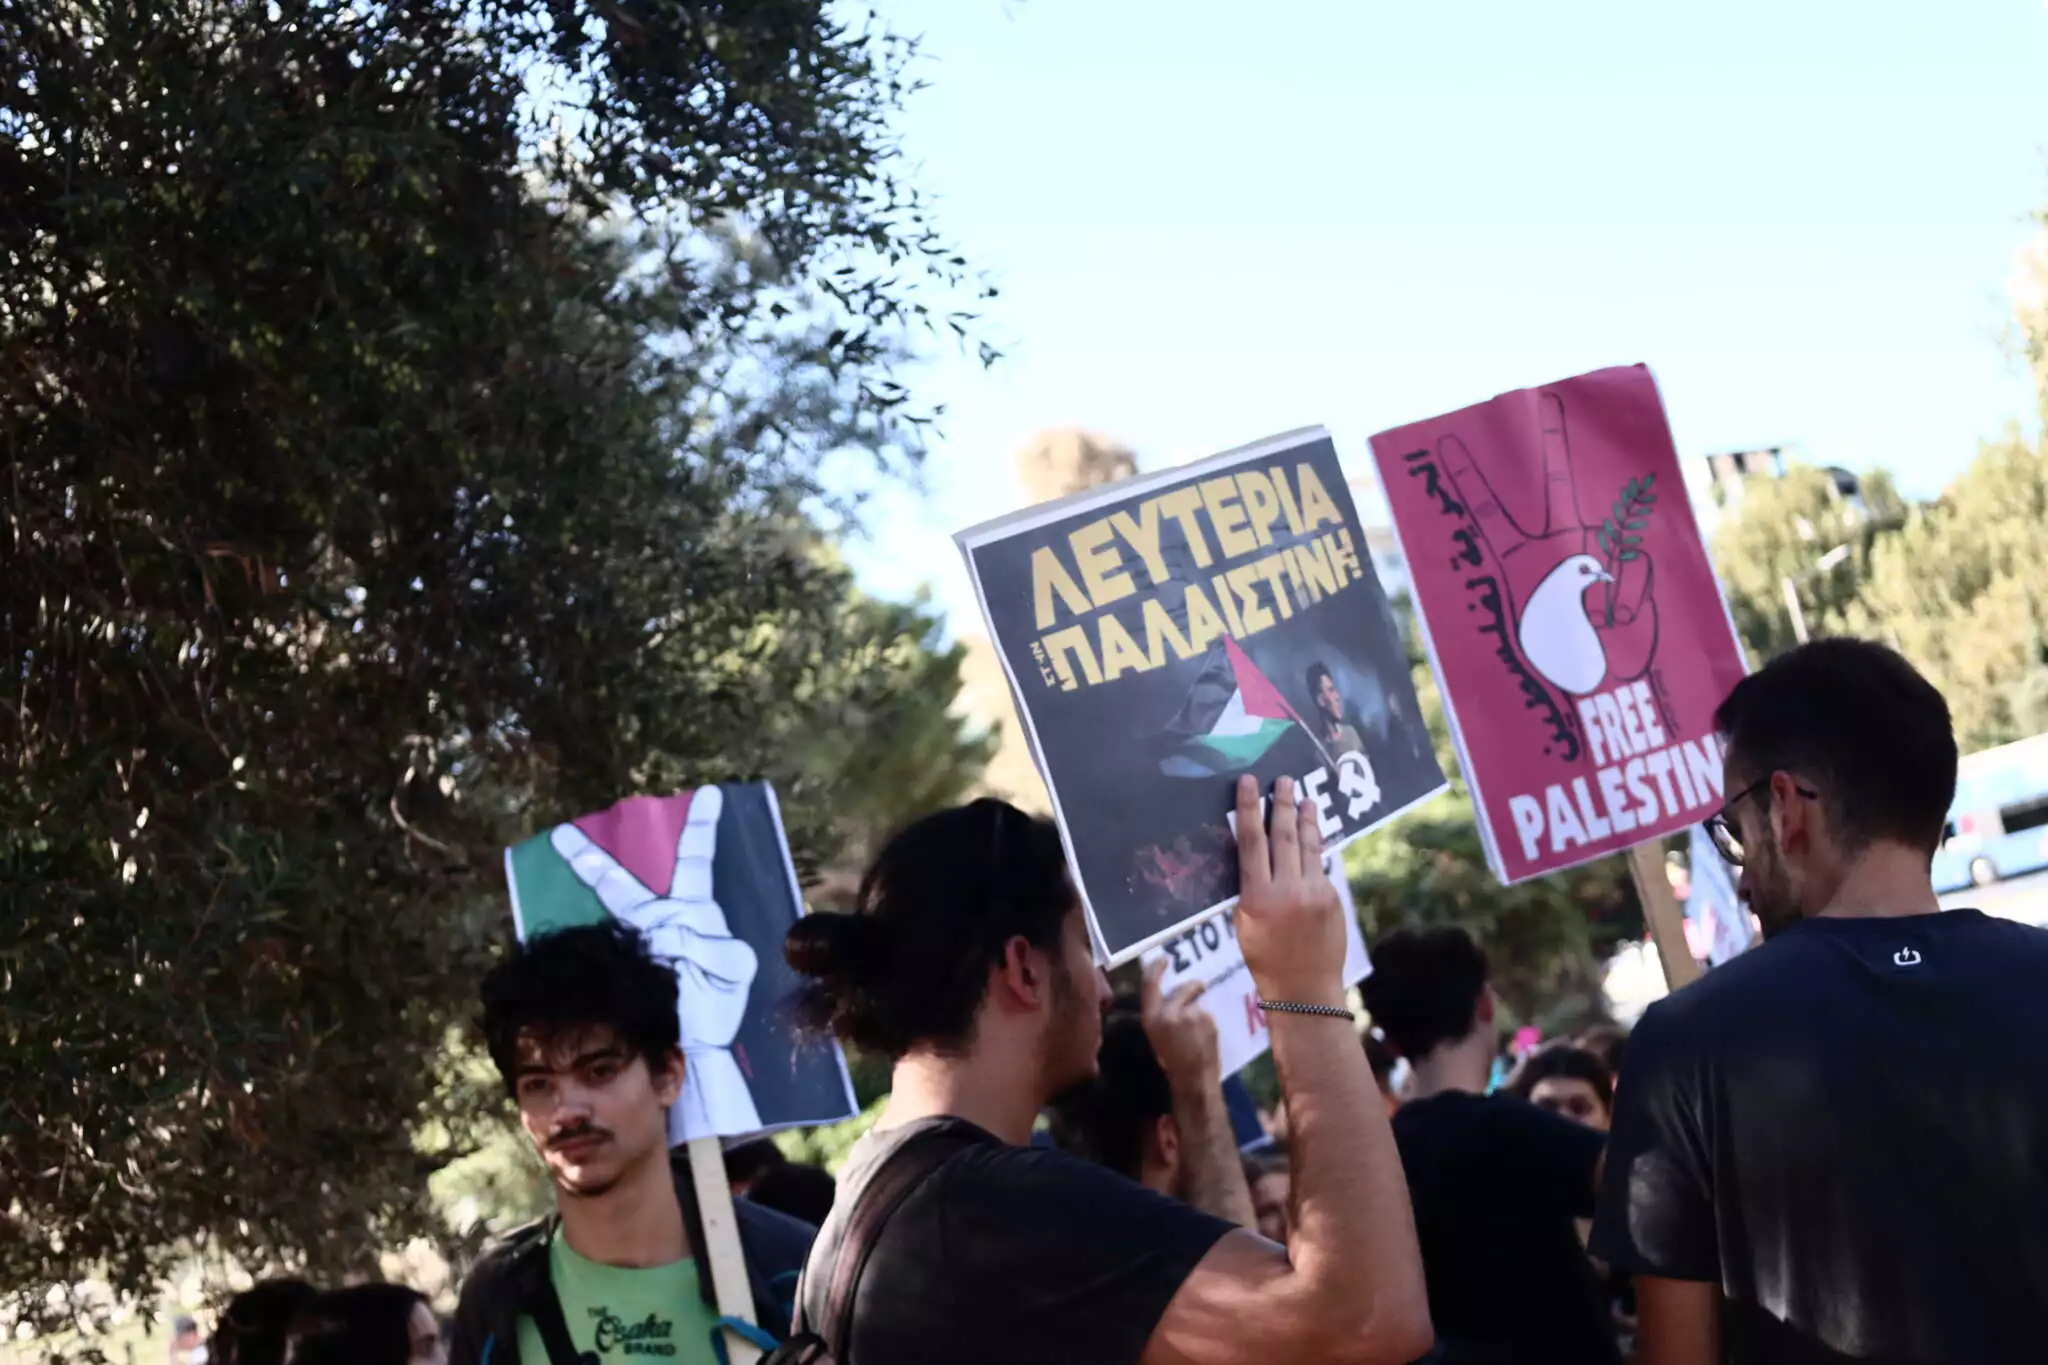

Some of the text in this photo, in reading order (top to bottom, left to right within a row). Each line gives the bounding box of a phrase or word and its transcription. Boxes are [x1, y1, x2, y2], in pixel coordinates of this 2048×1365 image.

[1030, 463, 1344, 630] ΛΕΥΤΕΡΙΑ
[1403, 449, 1579, 762] الحرية لفلسطين
[1578, 681, 1665, 765] FREE
[1508, 733, 1727, 861] PALESTIN
